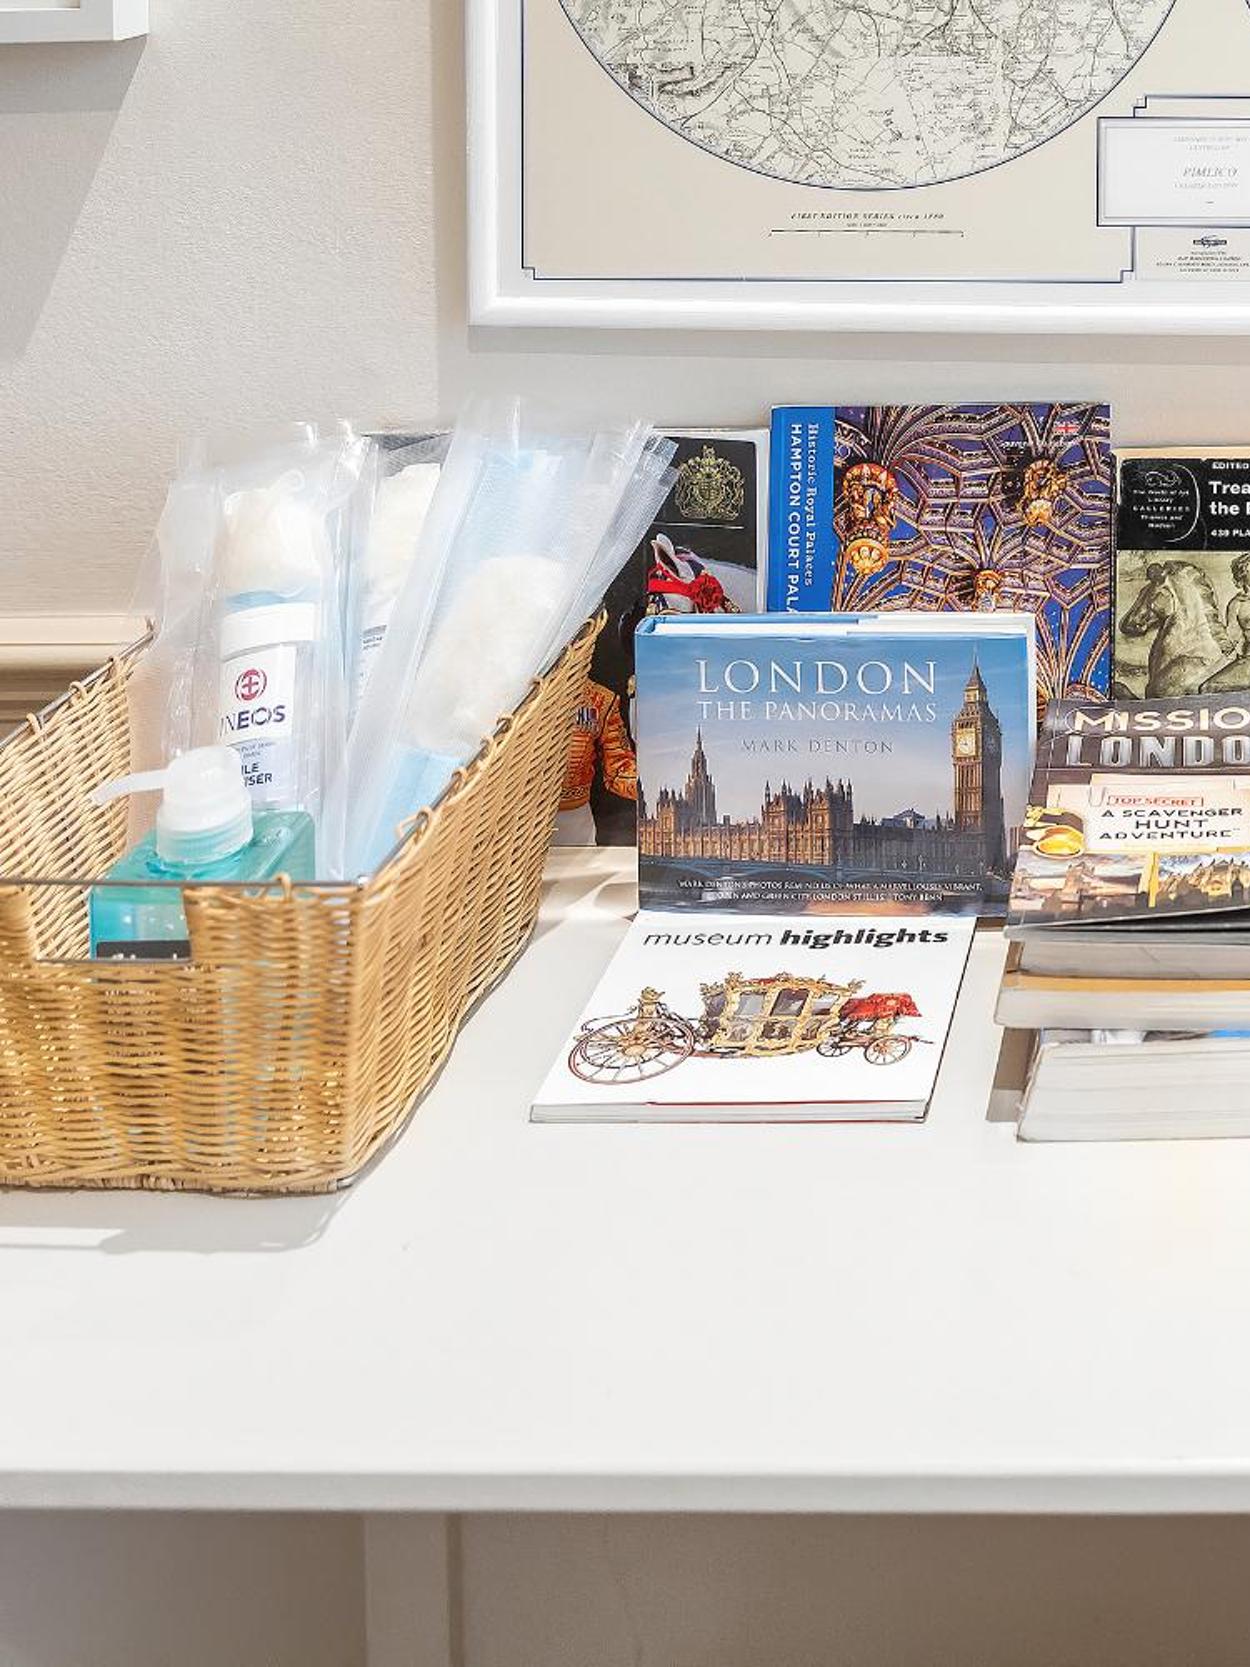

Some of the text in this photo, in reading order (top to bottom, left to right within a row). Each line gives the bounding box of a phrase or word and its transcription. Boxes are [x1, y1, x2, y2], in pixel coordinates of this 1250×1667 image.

[789, 424, 802, 507] HAMPTON
[1211, 462, 1250, 470] EDITED
[804, 424, 819, 587] Historic Royal Palaces
[1209, 501, 1241, 515] the
[788, 512, 801, 569] COURT
[696, 658, 938, 696] LONDON
[219, 704, 287, 737] INEOS
[697, 701, 938, 723] THE PANORAMAS
[740, 738, 894, 754] MARK DENTON
[1112, 796, 1197, 807] TOP SECRET
[1101, 808, 1244, 818] A SCAVENGER
[1134, 819, 1209, 830] HUNT
[643, 928, 949, 950] museum highlights
